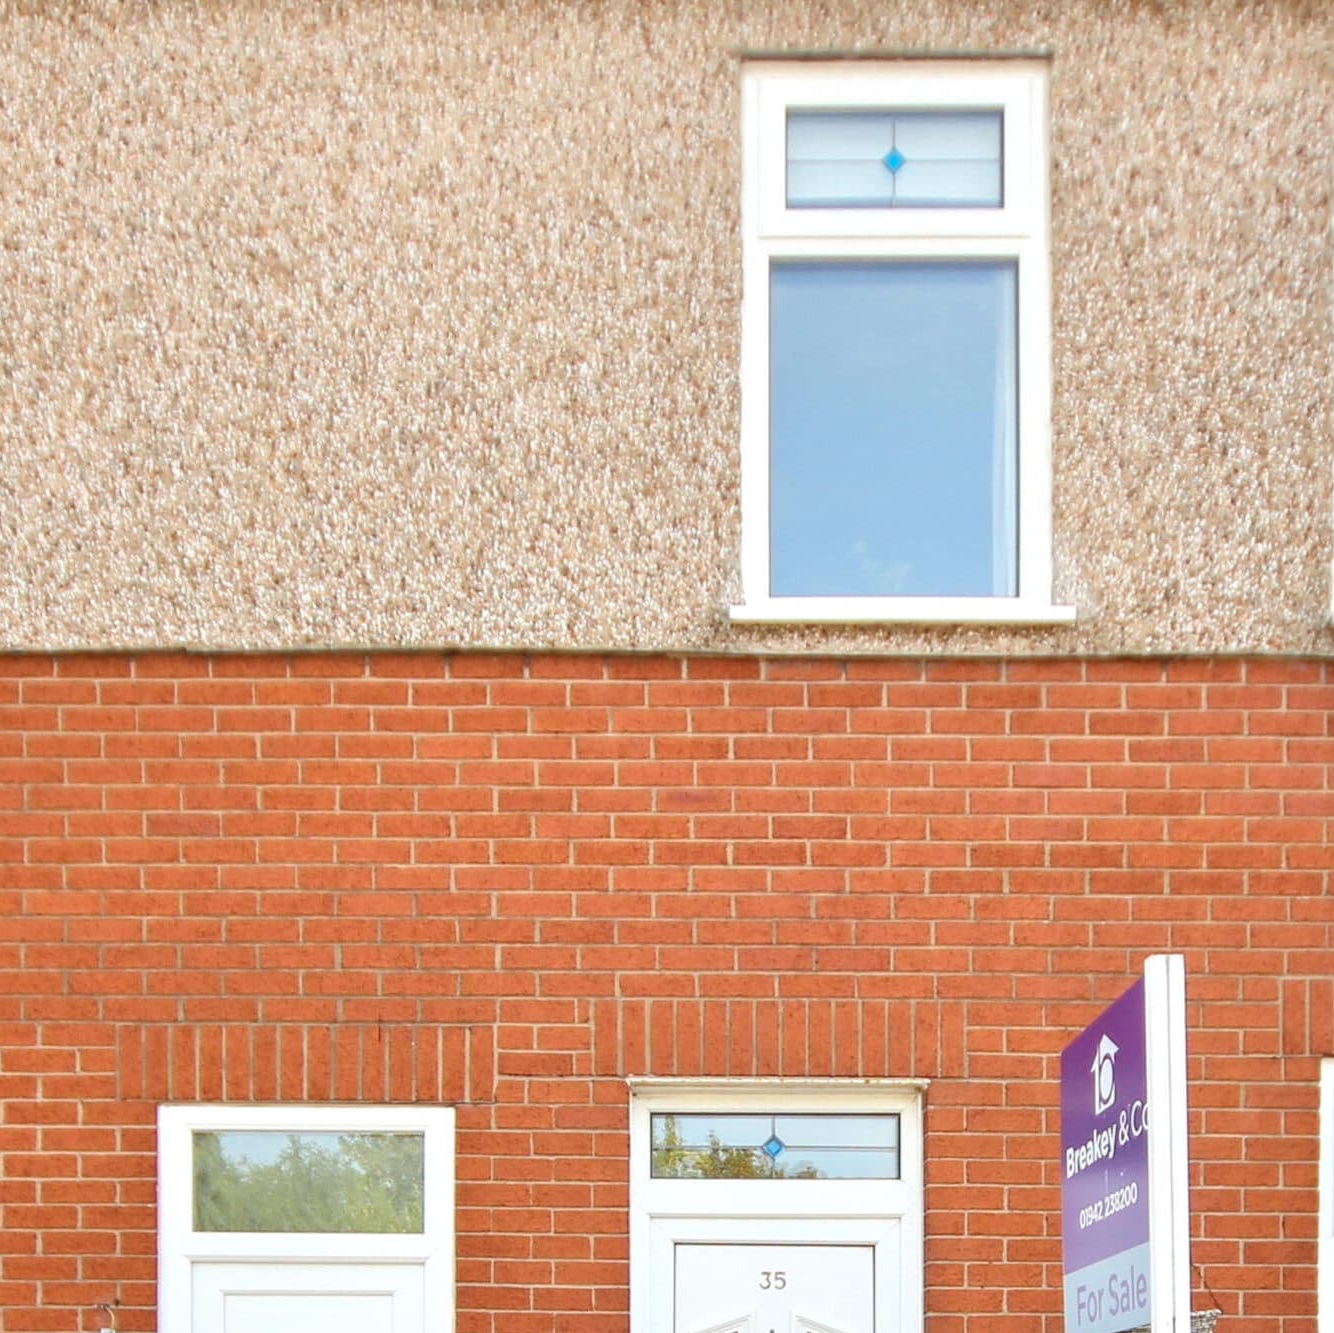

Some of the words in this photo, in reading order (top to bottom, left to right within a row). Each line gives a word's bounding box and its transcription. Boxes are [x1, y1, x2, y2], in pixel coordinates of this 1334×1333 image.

[1066, 1124, 1117, 1179] Breakey
[1118, 1110, 1129, 1146] &
[1079, 1202, 1103, 1230] 01942
[1104, 1182, 1138, 1217] 238200
[759, 1271, 787, 1290] 35
[1077, 1284, 1105, 1326] For
[1108, 1264, 1148, 1317] Sale
